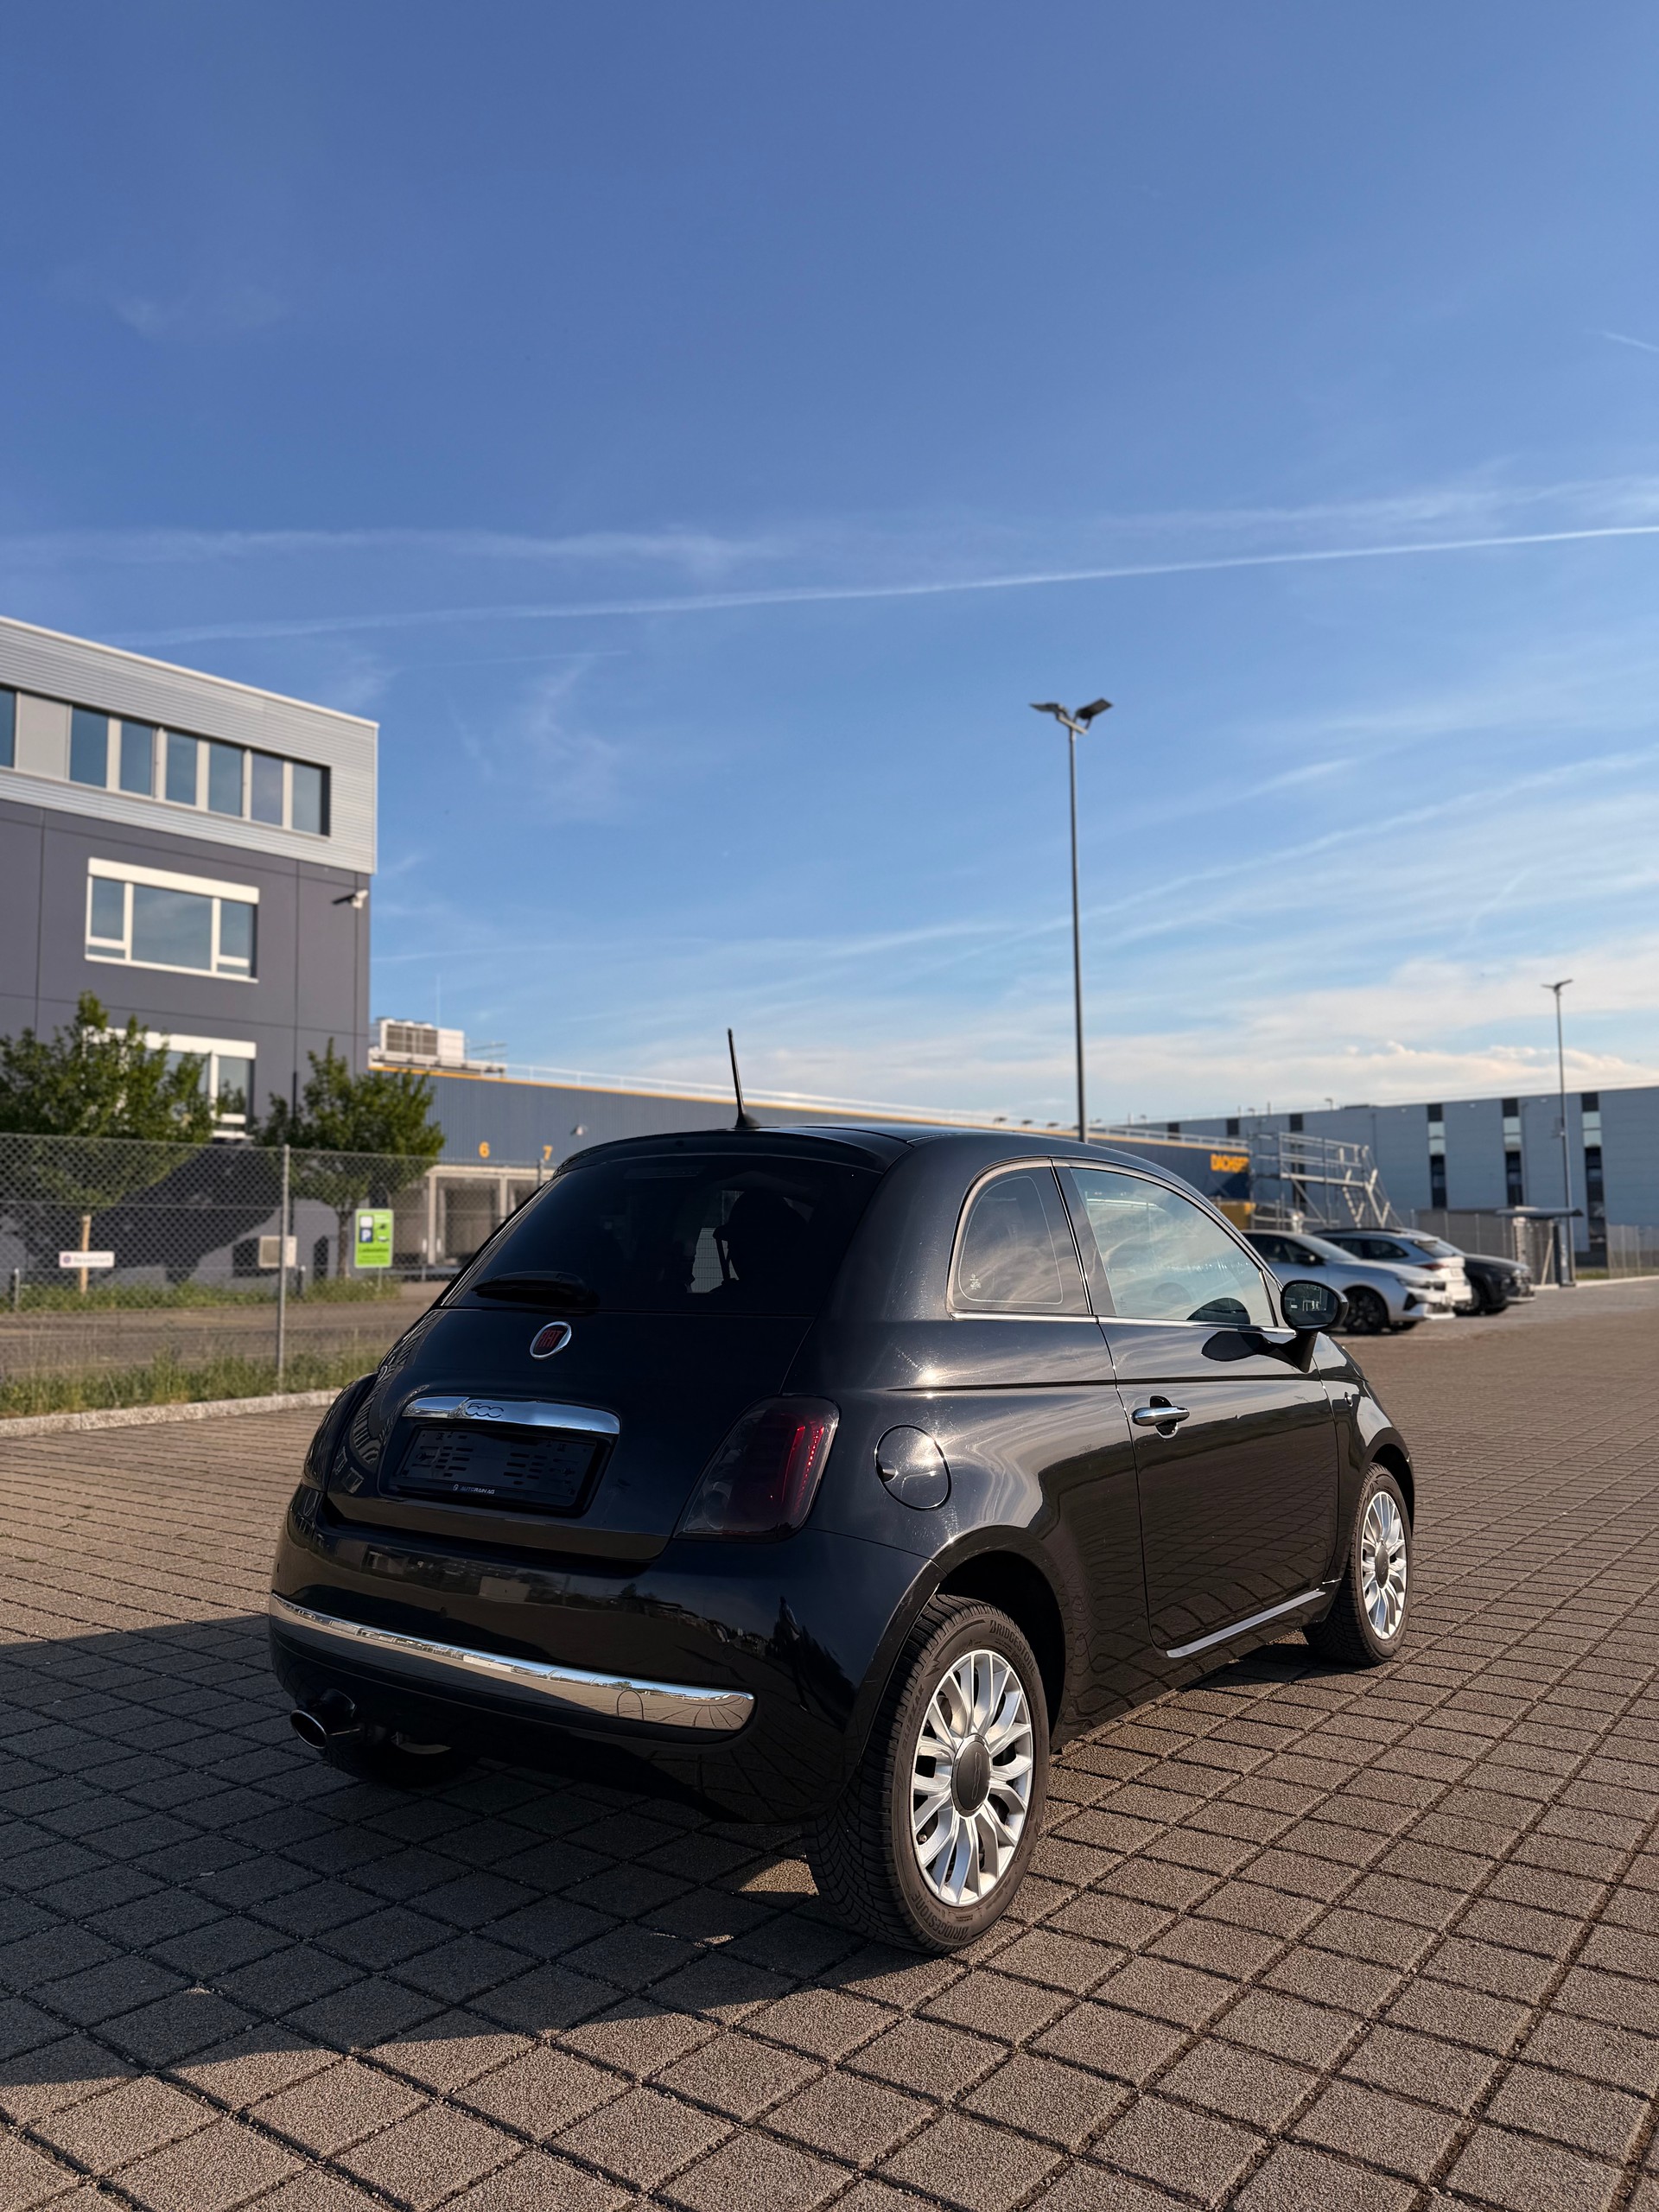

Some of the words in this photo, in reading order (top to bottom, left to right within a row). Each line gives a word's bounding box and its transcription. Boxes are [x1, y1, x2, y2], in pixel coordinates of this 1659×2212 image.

[479, 1141, 490, 1158] 6
[543, 1145, 553, 1160] 7
[361, 1229, 372, 1242] P
[536, 1329, 563, 1348] FIAT
[466, 1402, 504, 1418] 500
[989, 1619, 1037, 1676] BRIDGESTONE
[911, 1891, 969, 1942] BRIDGESTONE
